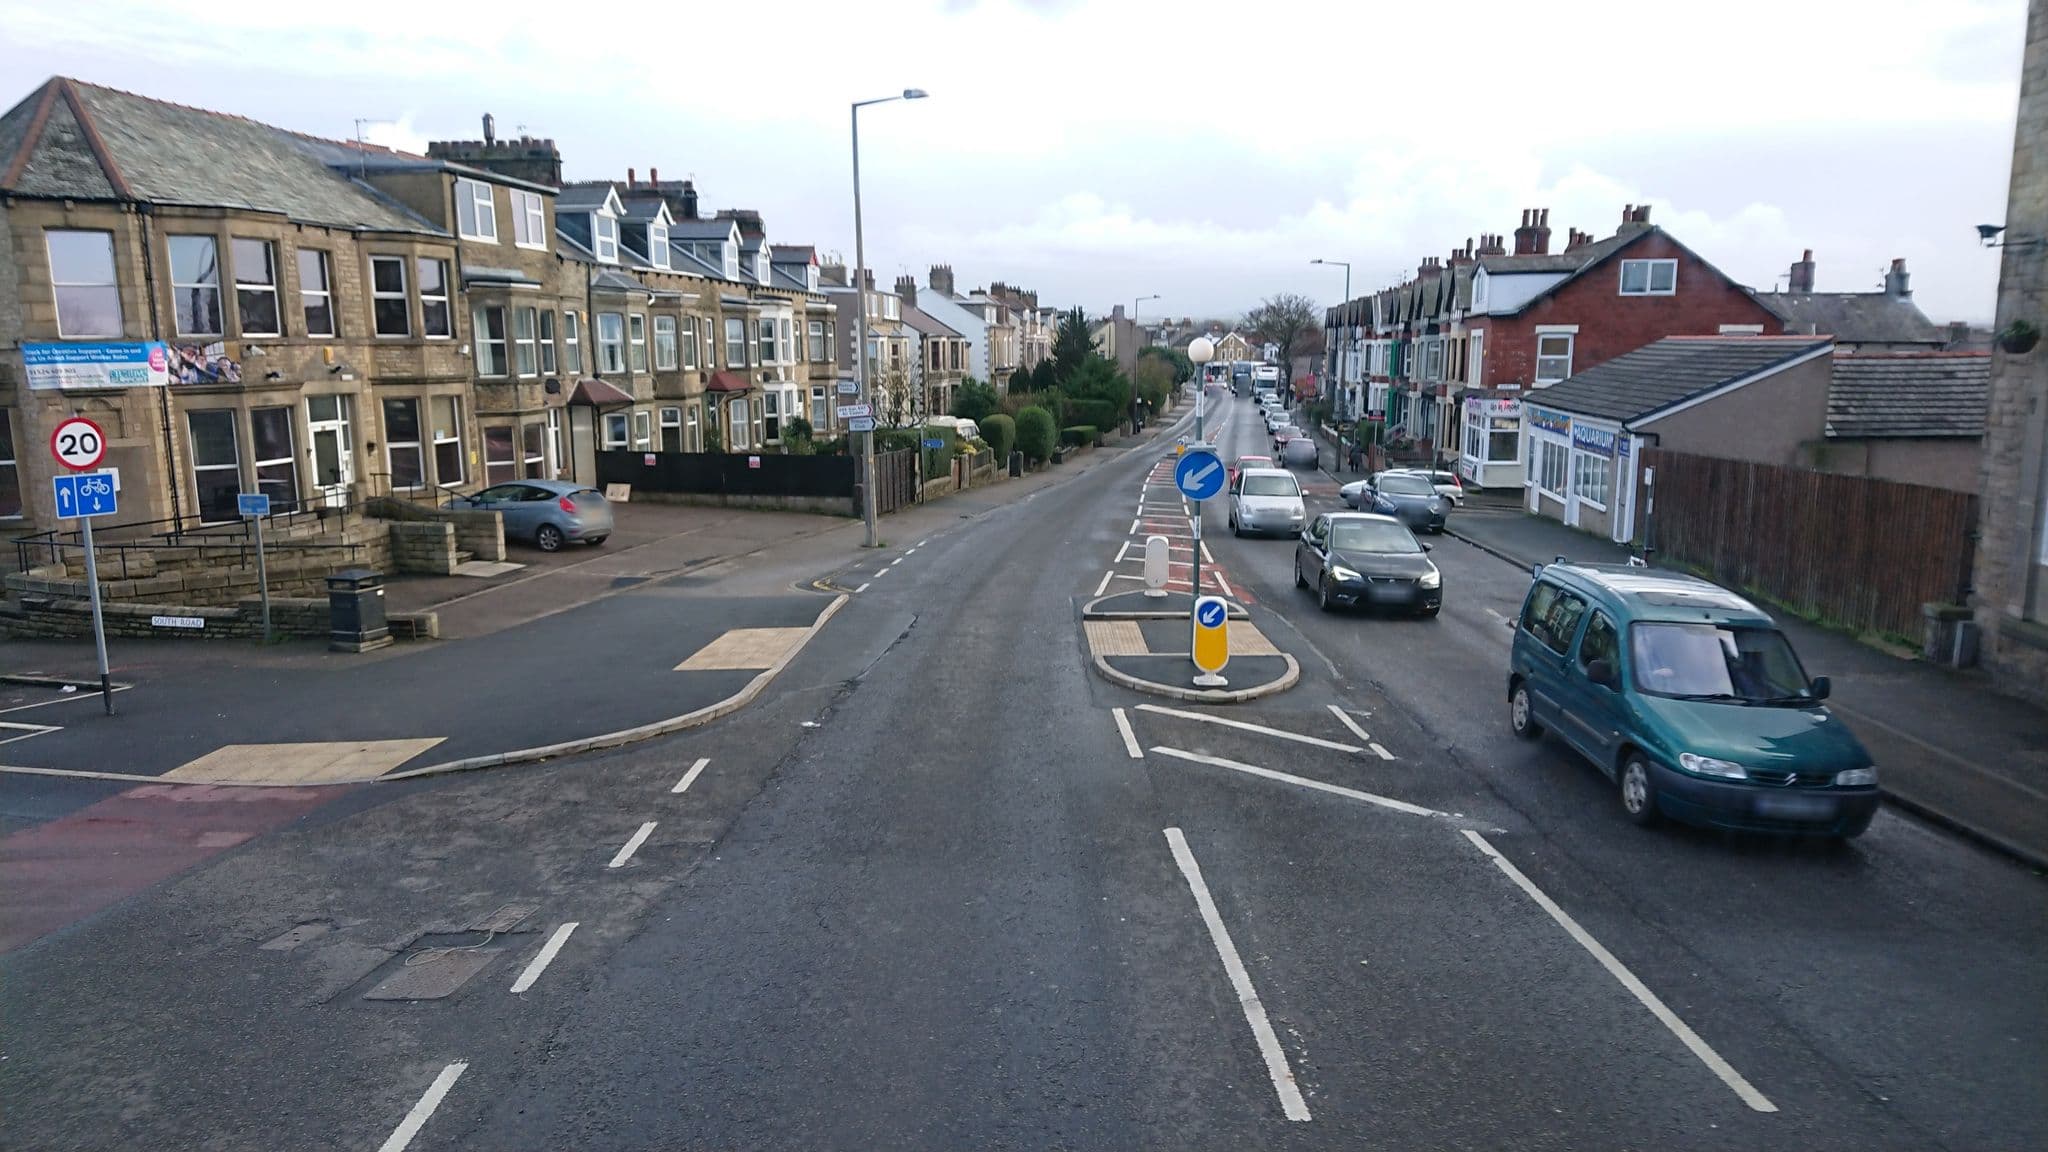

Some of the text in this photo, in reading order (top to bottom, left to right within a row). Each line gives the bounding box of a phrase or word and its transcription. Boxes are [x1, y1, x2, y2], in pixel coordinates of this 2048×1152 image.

[60, 432, 98, 456] 20
[1576, 426, 1613, 449] AQUARIUM
[154, 616, 202, 627] SOUTH ROAD
